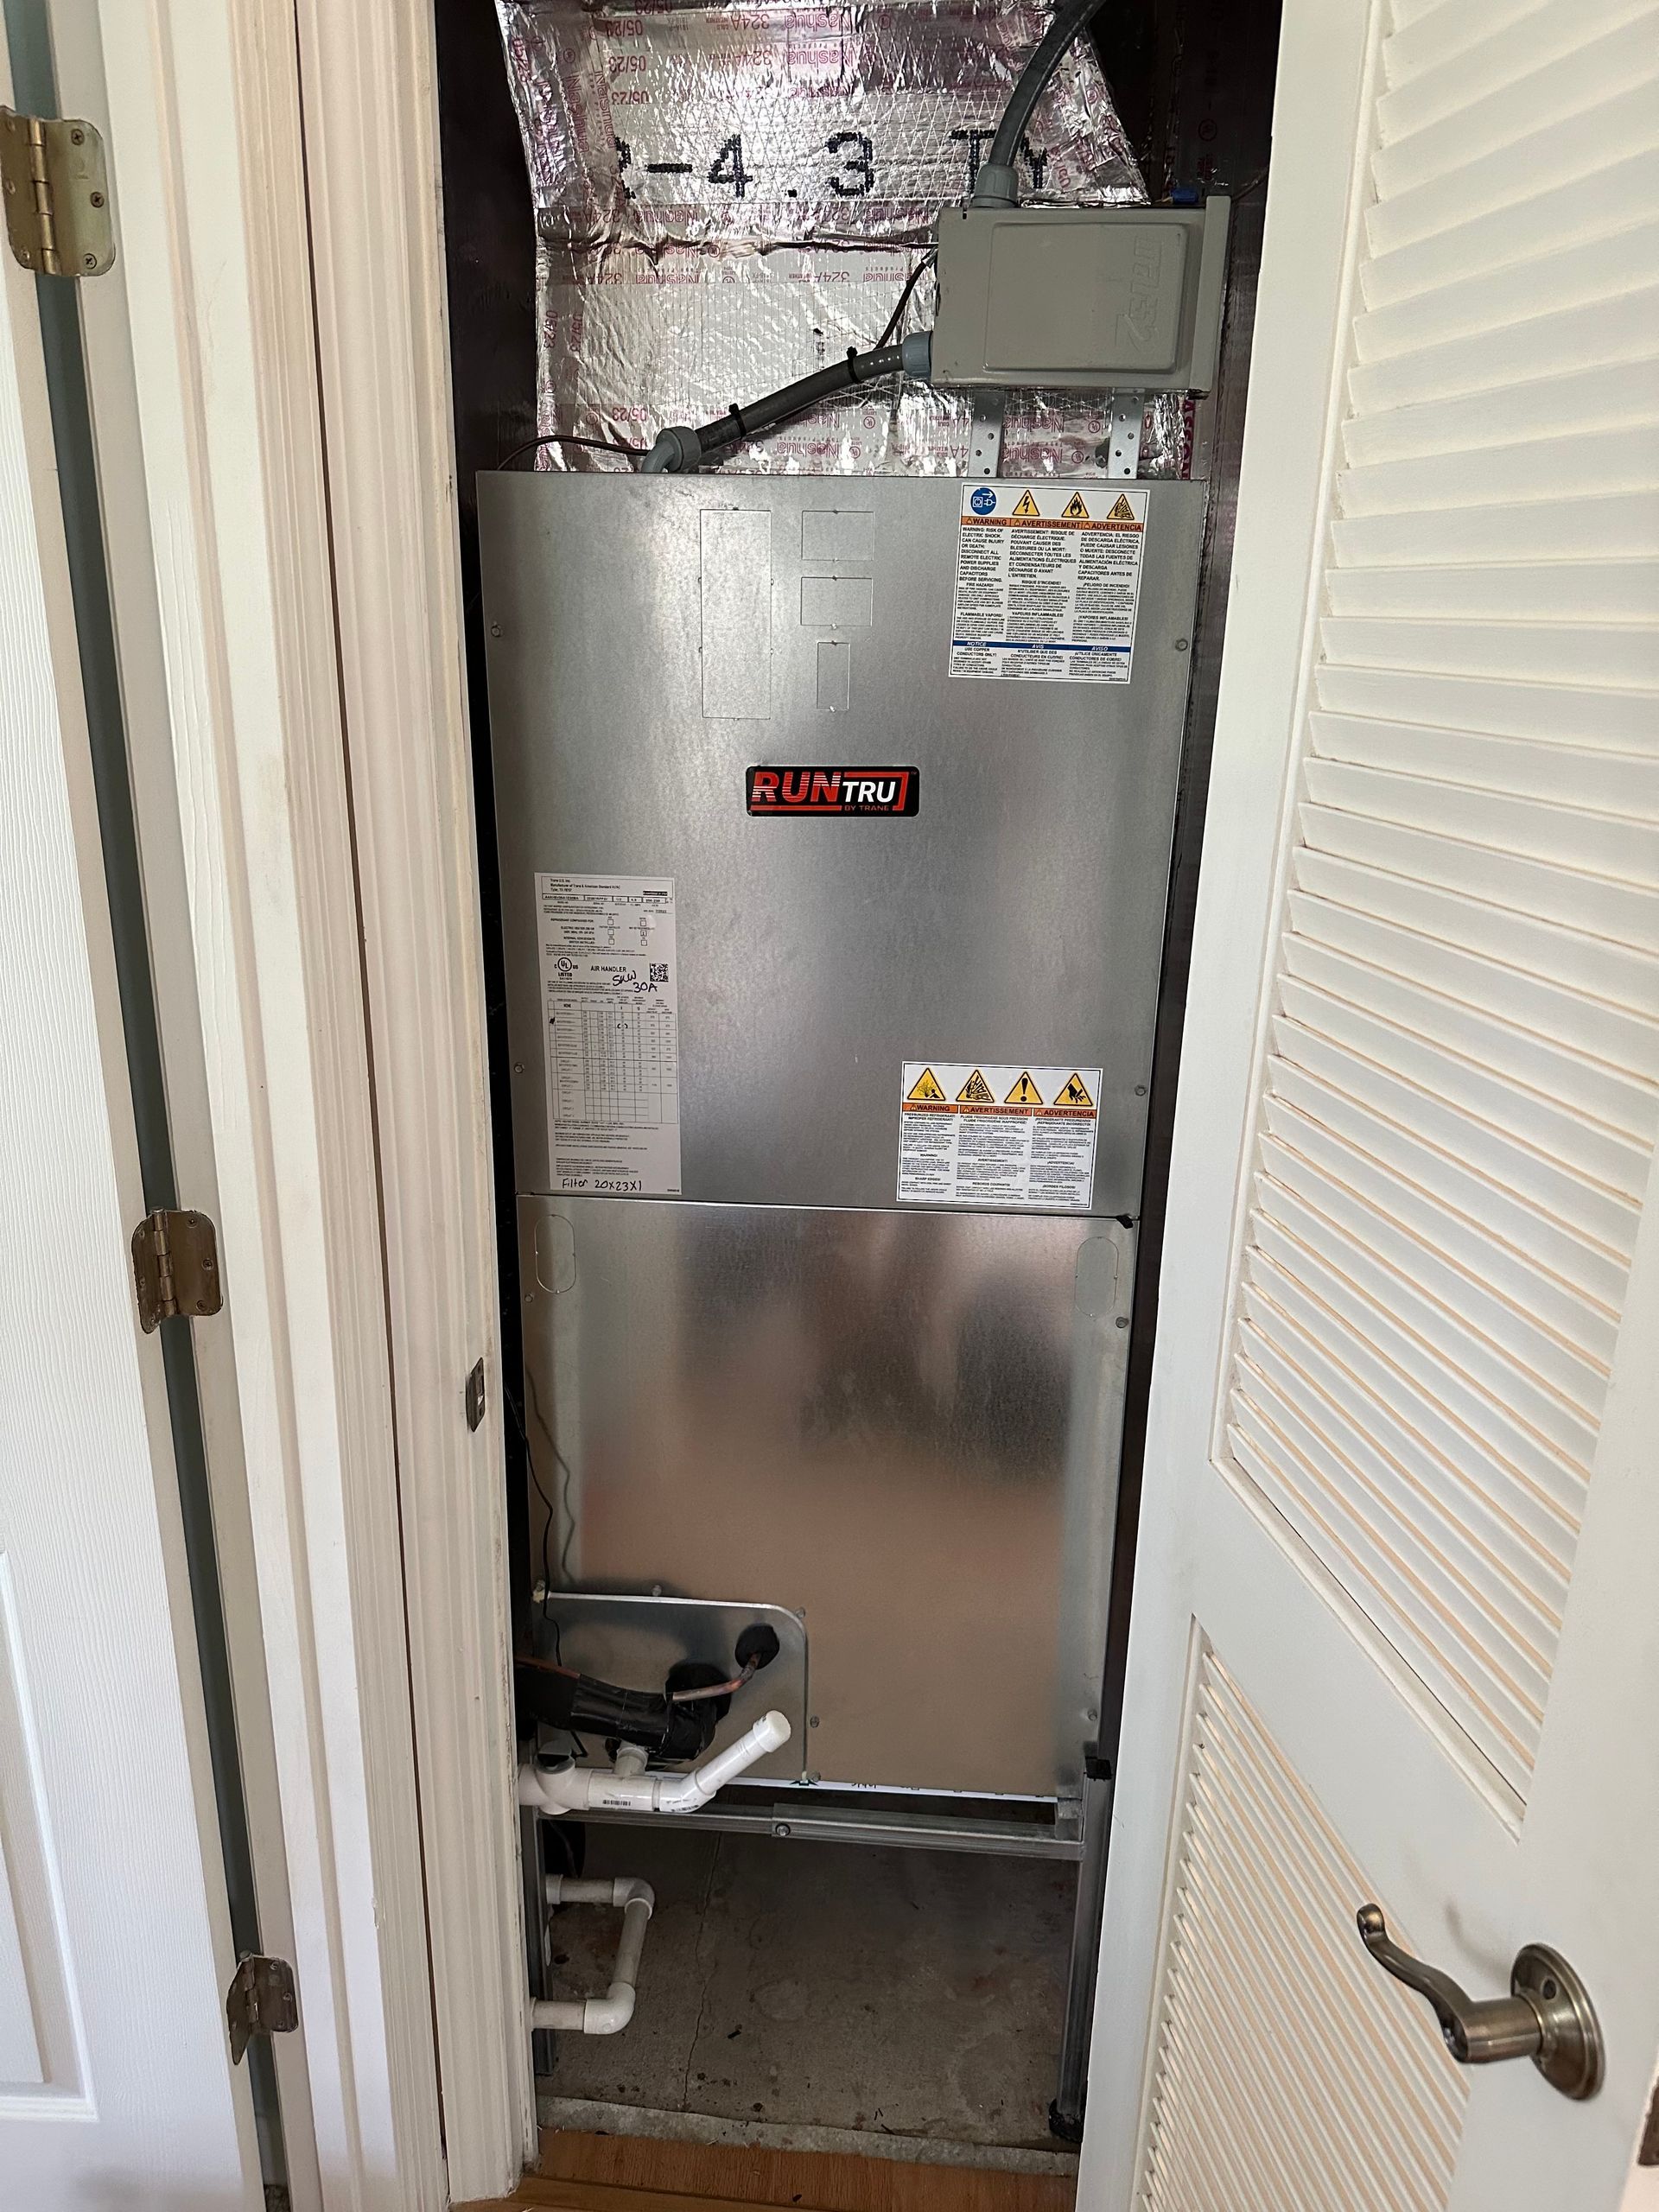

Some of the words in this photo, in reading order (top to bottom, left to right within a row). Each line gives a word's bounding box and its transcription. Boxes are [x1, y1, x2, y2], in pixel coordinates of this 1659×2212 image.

[1021, 519, 1080, 528] AVERTISSEMENT
[633, 982, 658, 993] 30A
[563, 1178, 588, 1189] Filter
